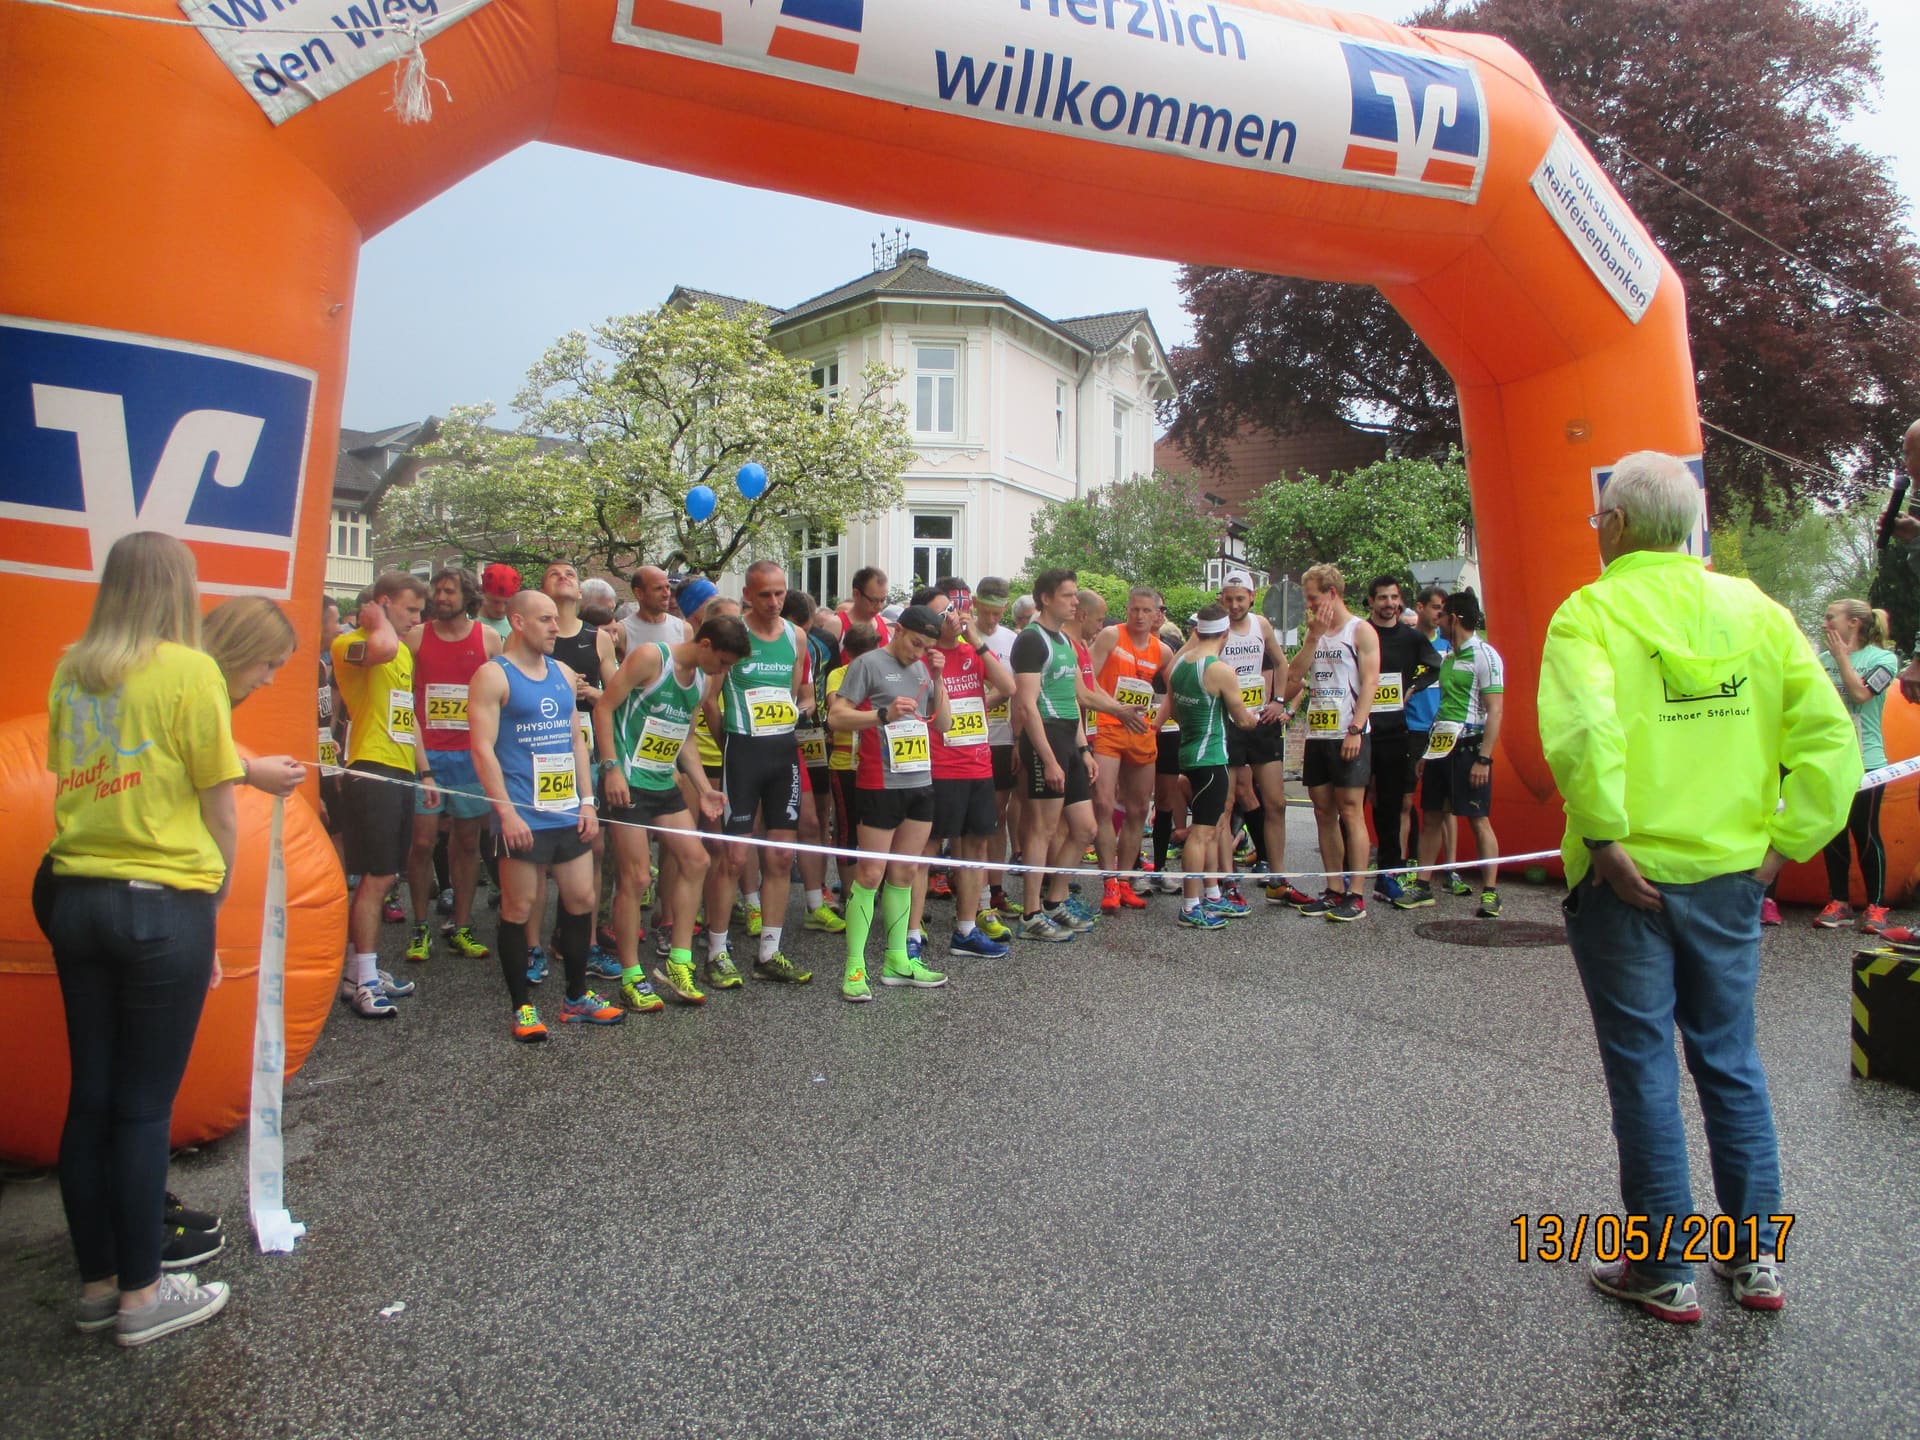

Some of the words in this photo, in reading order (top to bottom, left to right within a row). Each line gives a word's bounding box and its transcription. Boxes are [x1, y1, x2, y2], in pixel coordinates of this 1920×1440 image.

[1020, 0, 1247, 61] erzlich
[252, 37, 335, 97] den
[935, 45, 1297, 164] willkommen
[1569, 162, 1643, 270] Volksbanken
[1543, 164, 1647, 308] Raiffeisenbanken
[1225, 644, 1261, 656] ERDINGER
[1119, 691, 1149, 707] 2280
[950, 714, 983, 731] 2343
[1308, 712, 1337, 725] 2381
[1659, 712, 1702, 722] Itzehoer
[1707, 707, 1750, 718] Störlauf
[642, 736, 680, 757] 2469
[894, 739, 927, 756] 2711
[1431, 735, 1453, 748] 2375
[57, 754, 111, 798] rlauf-
[94, 770, 143, 803] Team
[540, 774, 574, 793] 2644
[788, 763, 799, 806] Itzehoer
